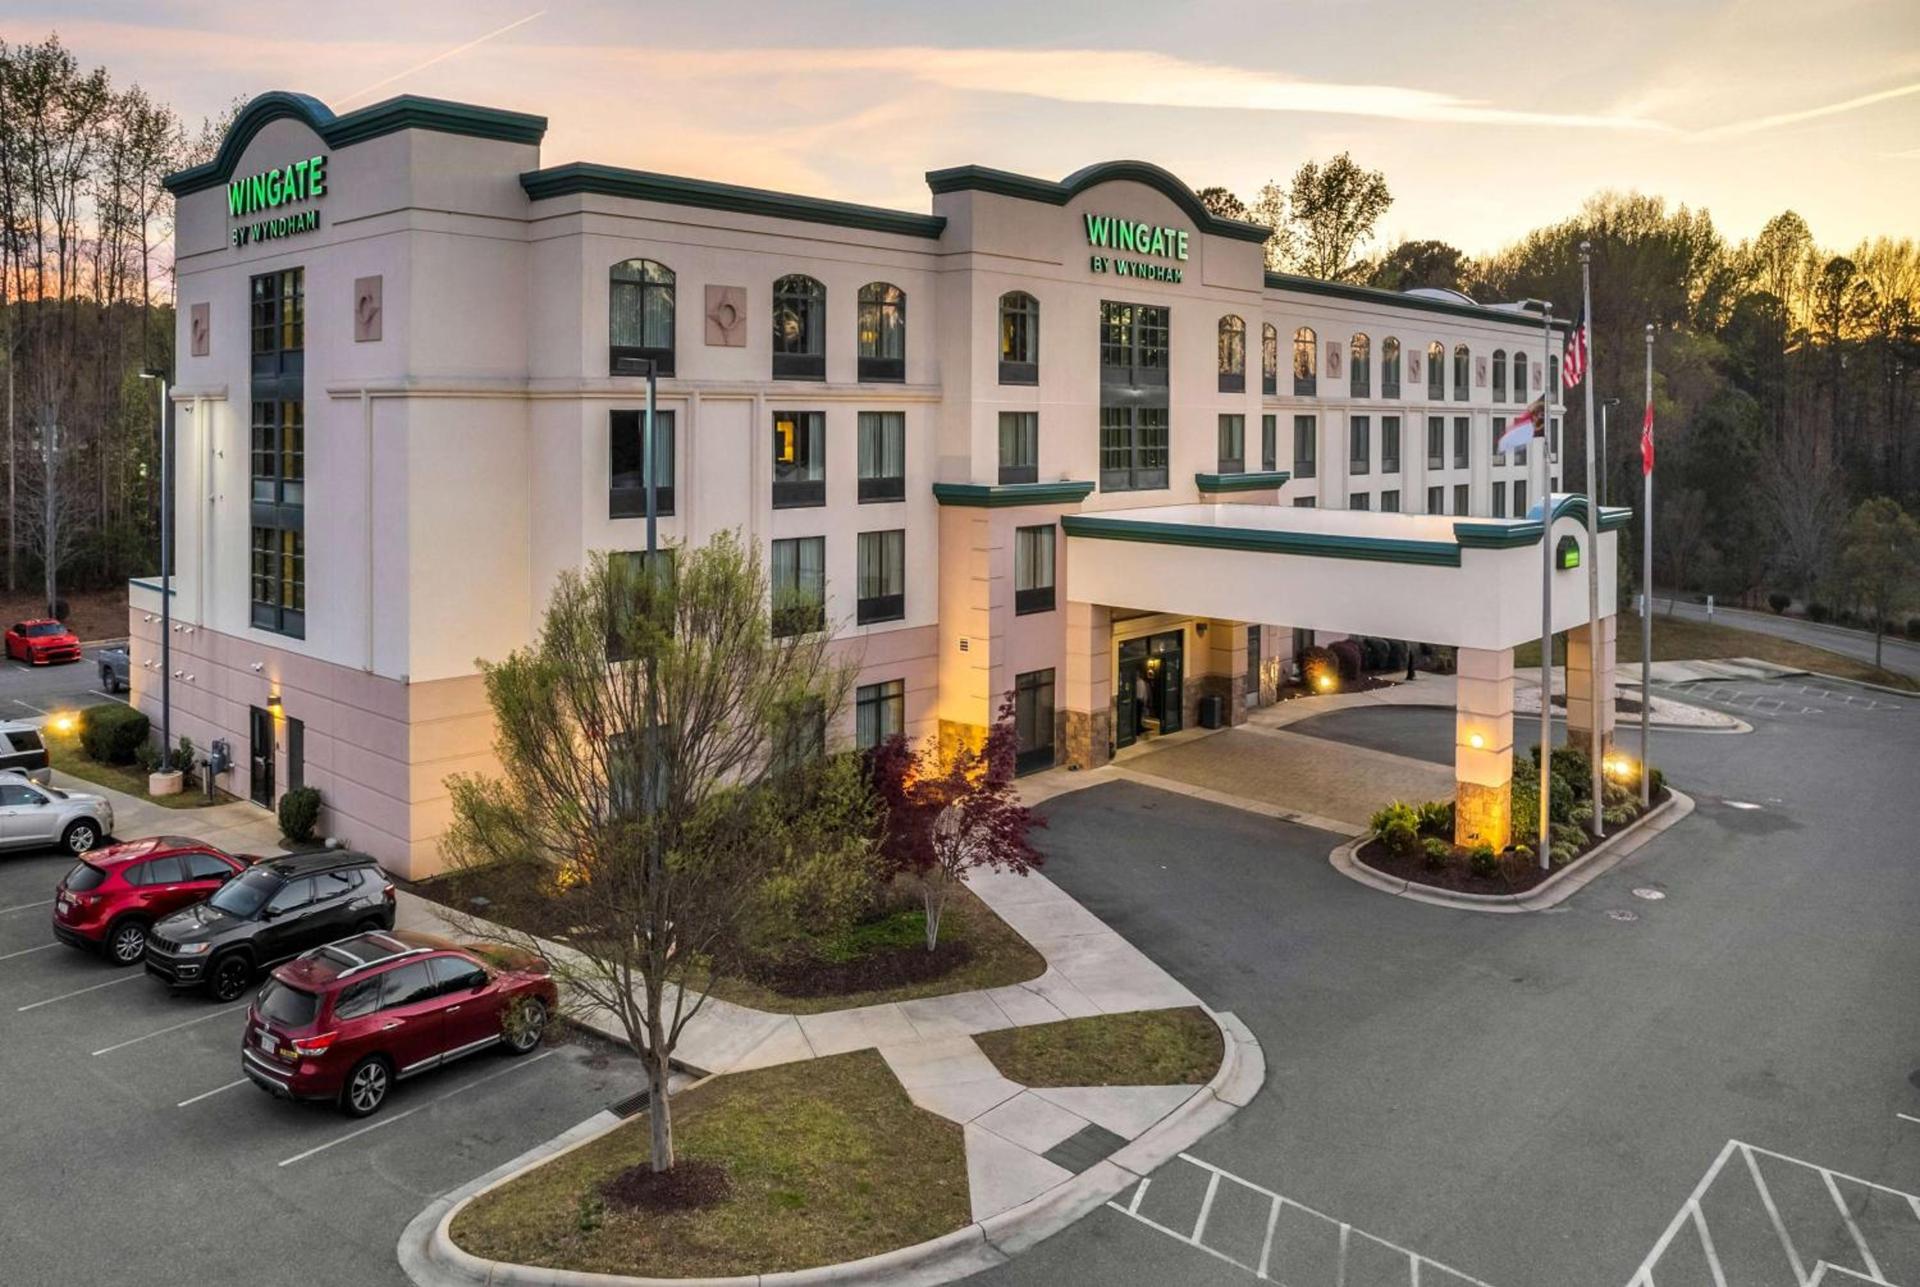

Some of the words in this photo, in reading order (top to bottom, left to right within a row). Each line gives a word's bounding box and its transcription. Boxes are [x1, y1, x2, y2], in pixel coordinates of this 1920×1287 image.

[228, 155, 324, 217] WINGATE
[232, 225, 248, 247] BY
[251, 210, 317, 242] WYNDHAM
[1086, 213, 1189, 261] WINGATE
[1092, 256, 1109, 274] BY
[1115, 259, 1183, 284] WYNDHAM
